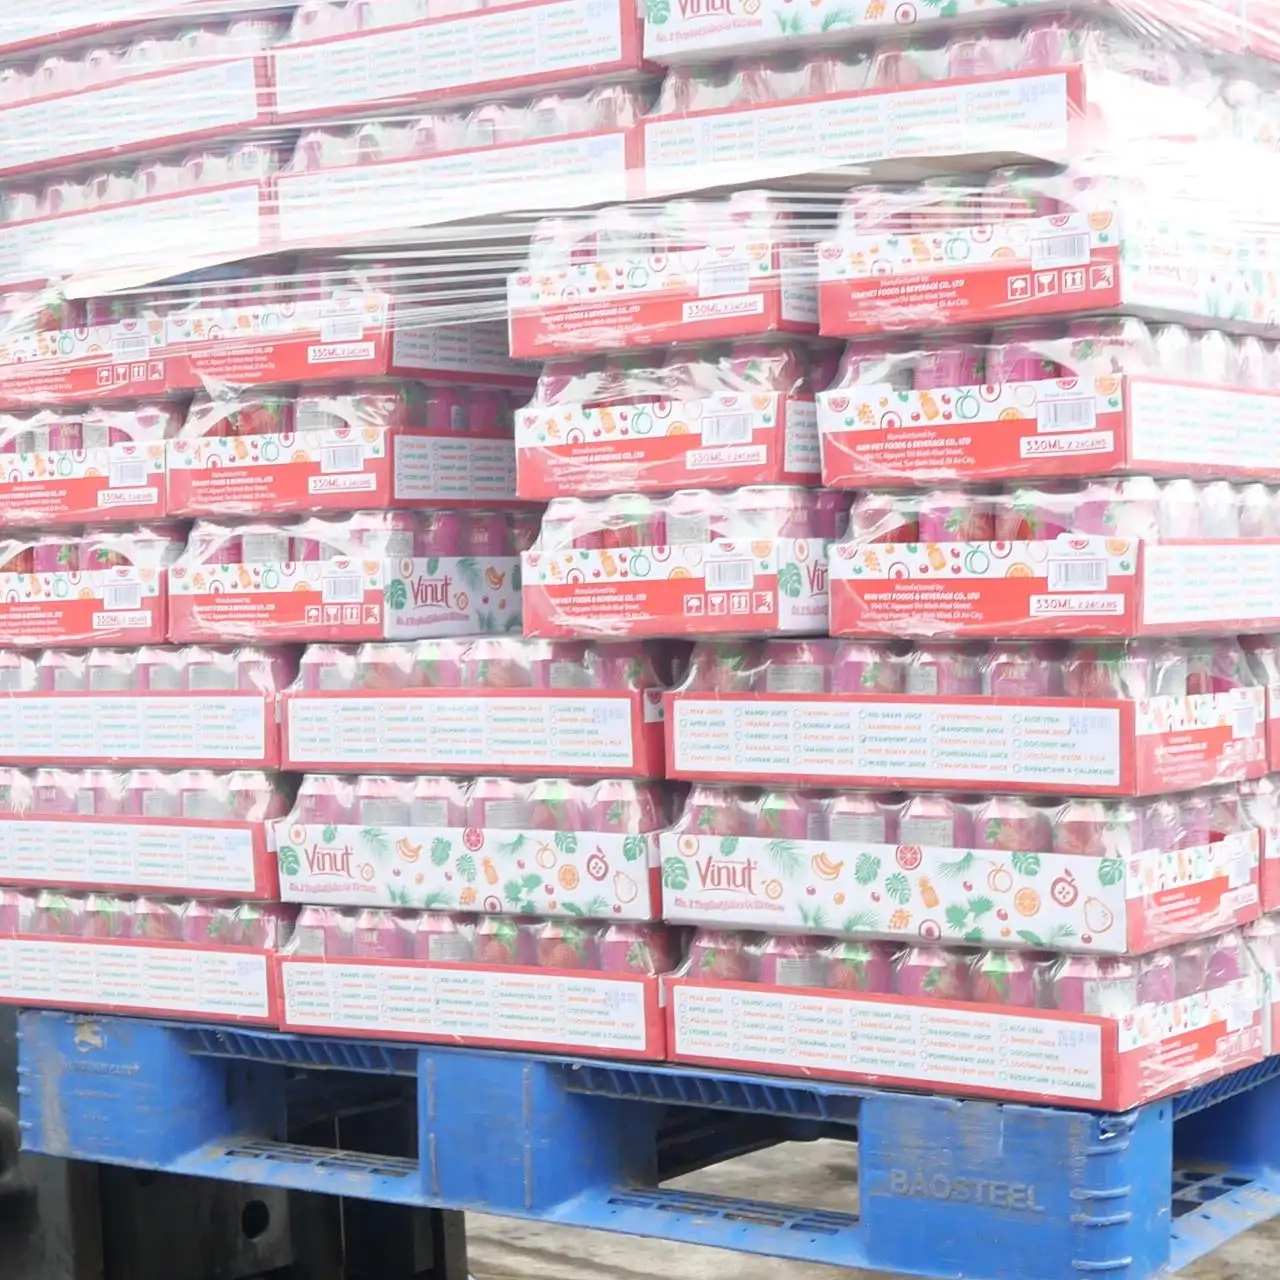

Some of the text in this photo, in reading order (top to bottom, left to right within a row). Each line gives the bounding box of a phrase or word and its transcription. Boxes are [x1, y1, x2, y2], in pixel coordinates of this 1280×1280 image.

[1026, 439, 1064, 451] 330ML
[410, 574, 453, 608] Vinut
[1036, 598, 1074, 609] 330ML
[304, 843, 354, 879] Vinut
[695, 856, 758, 896] Vinut
[890, 1169, 1046, 1212] BAOSTEEL
